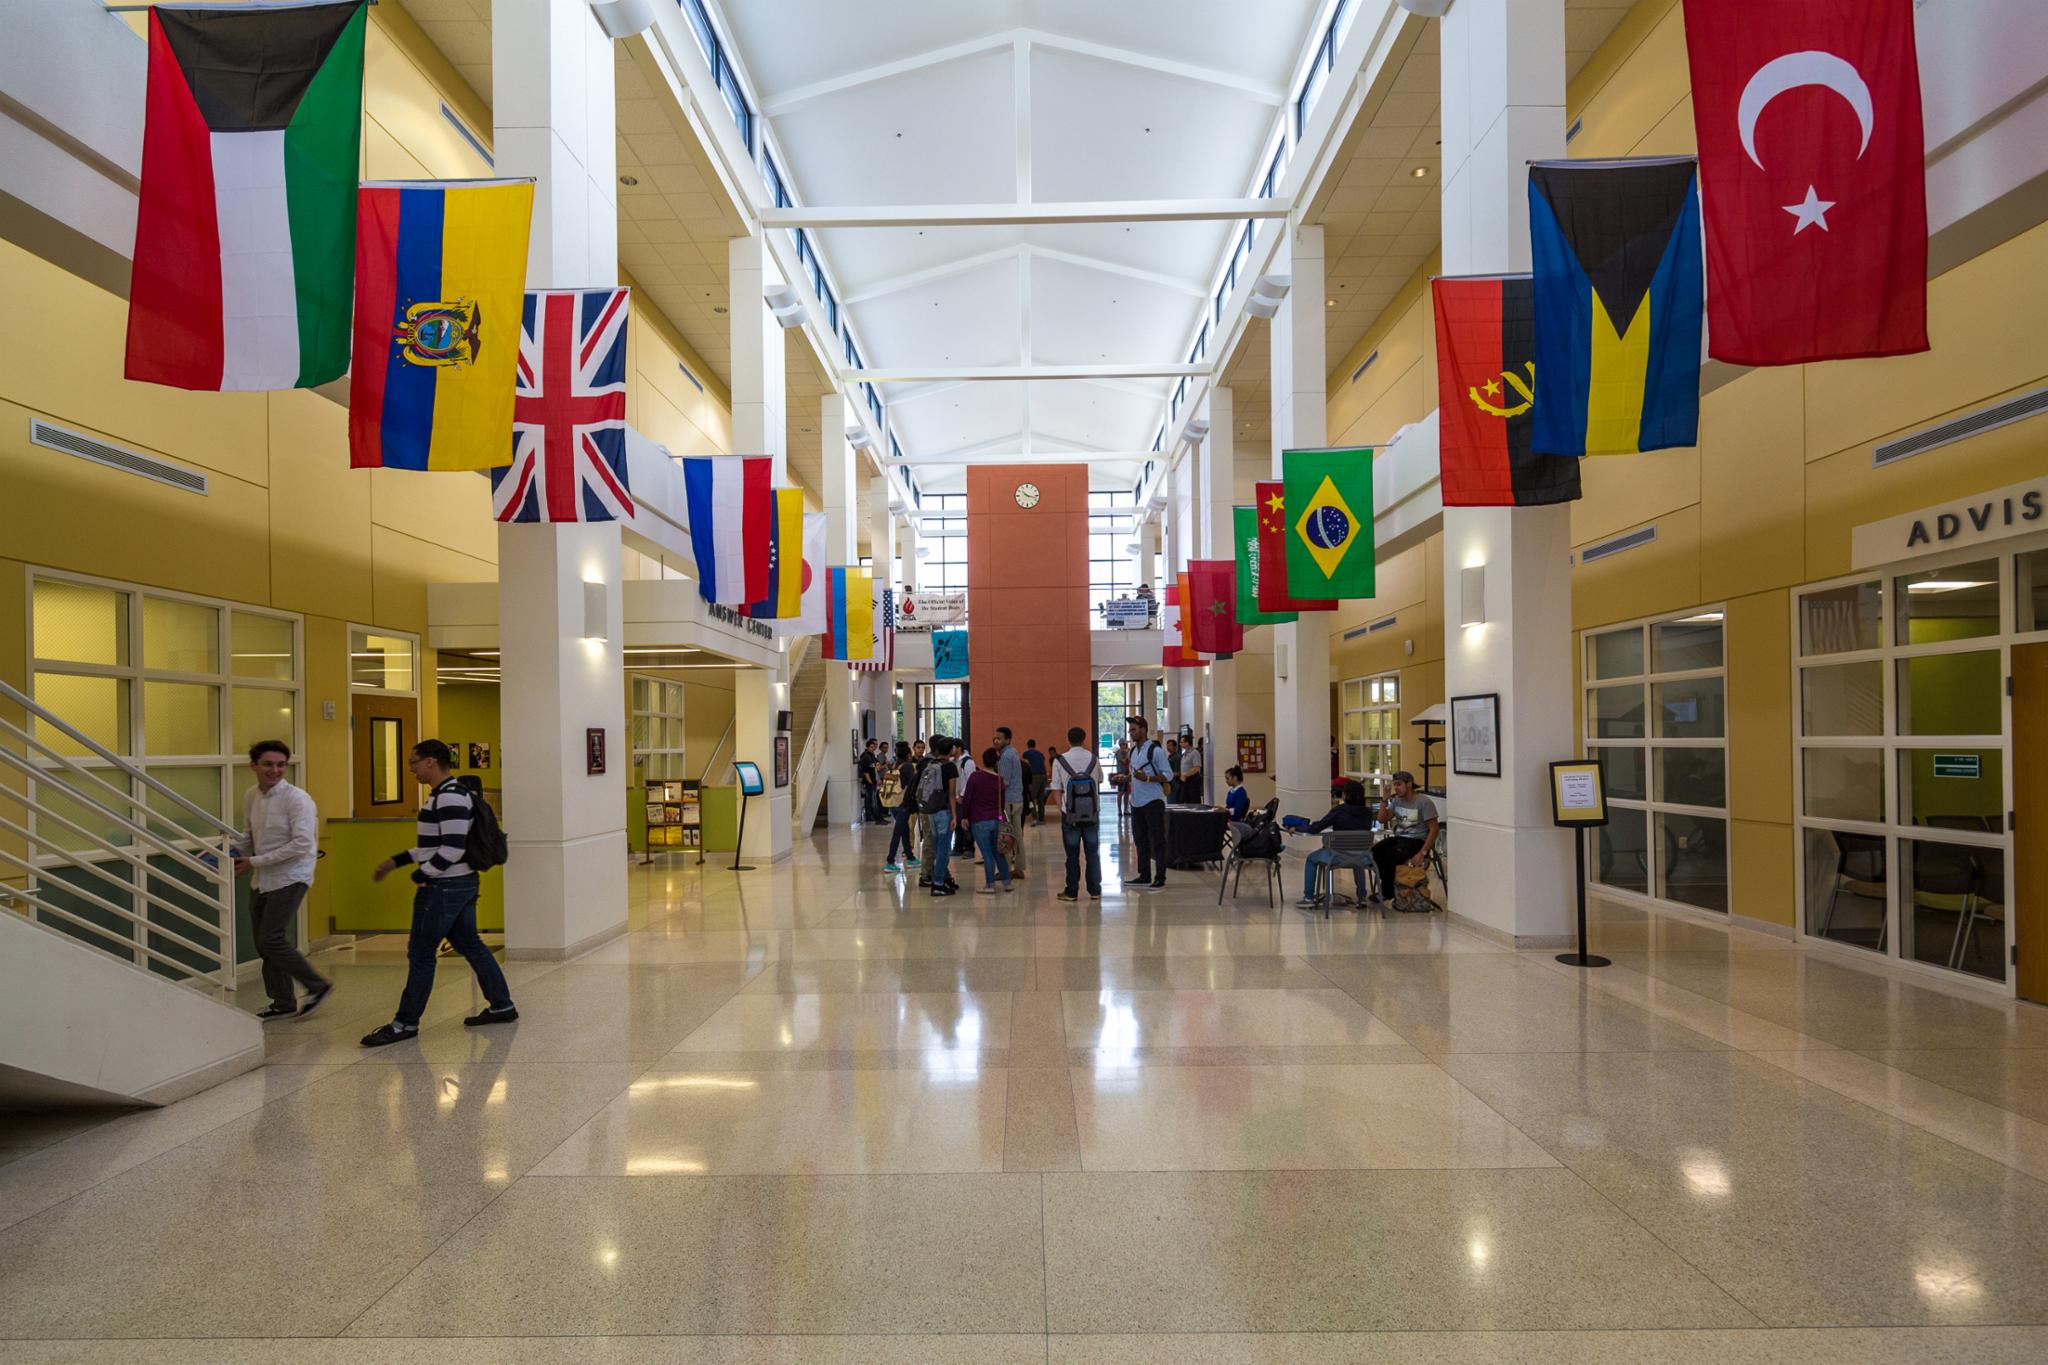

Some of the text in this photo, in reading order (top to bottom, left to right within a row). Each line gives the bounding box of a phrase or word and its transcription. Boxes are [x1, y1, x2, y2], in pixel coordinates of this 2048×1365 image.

[1906, 491, 2043, 548] ADVIS
[708, 603, 773, 640] ANSWER CENTER
